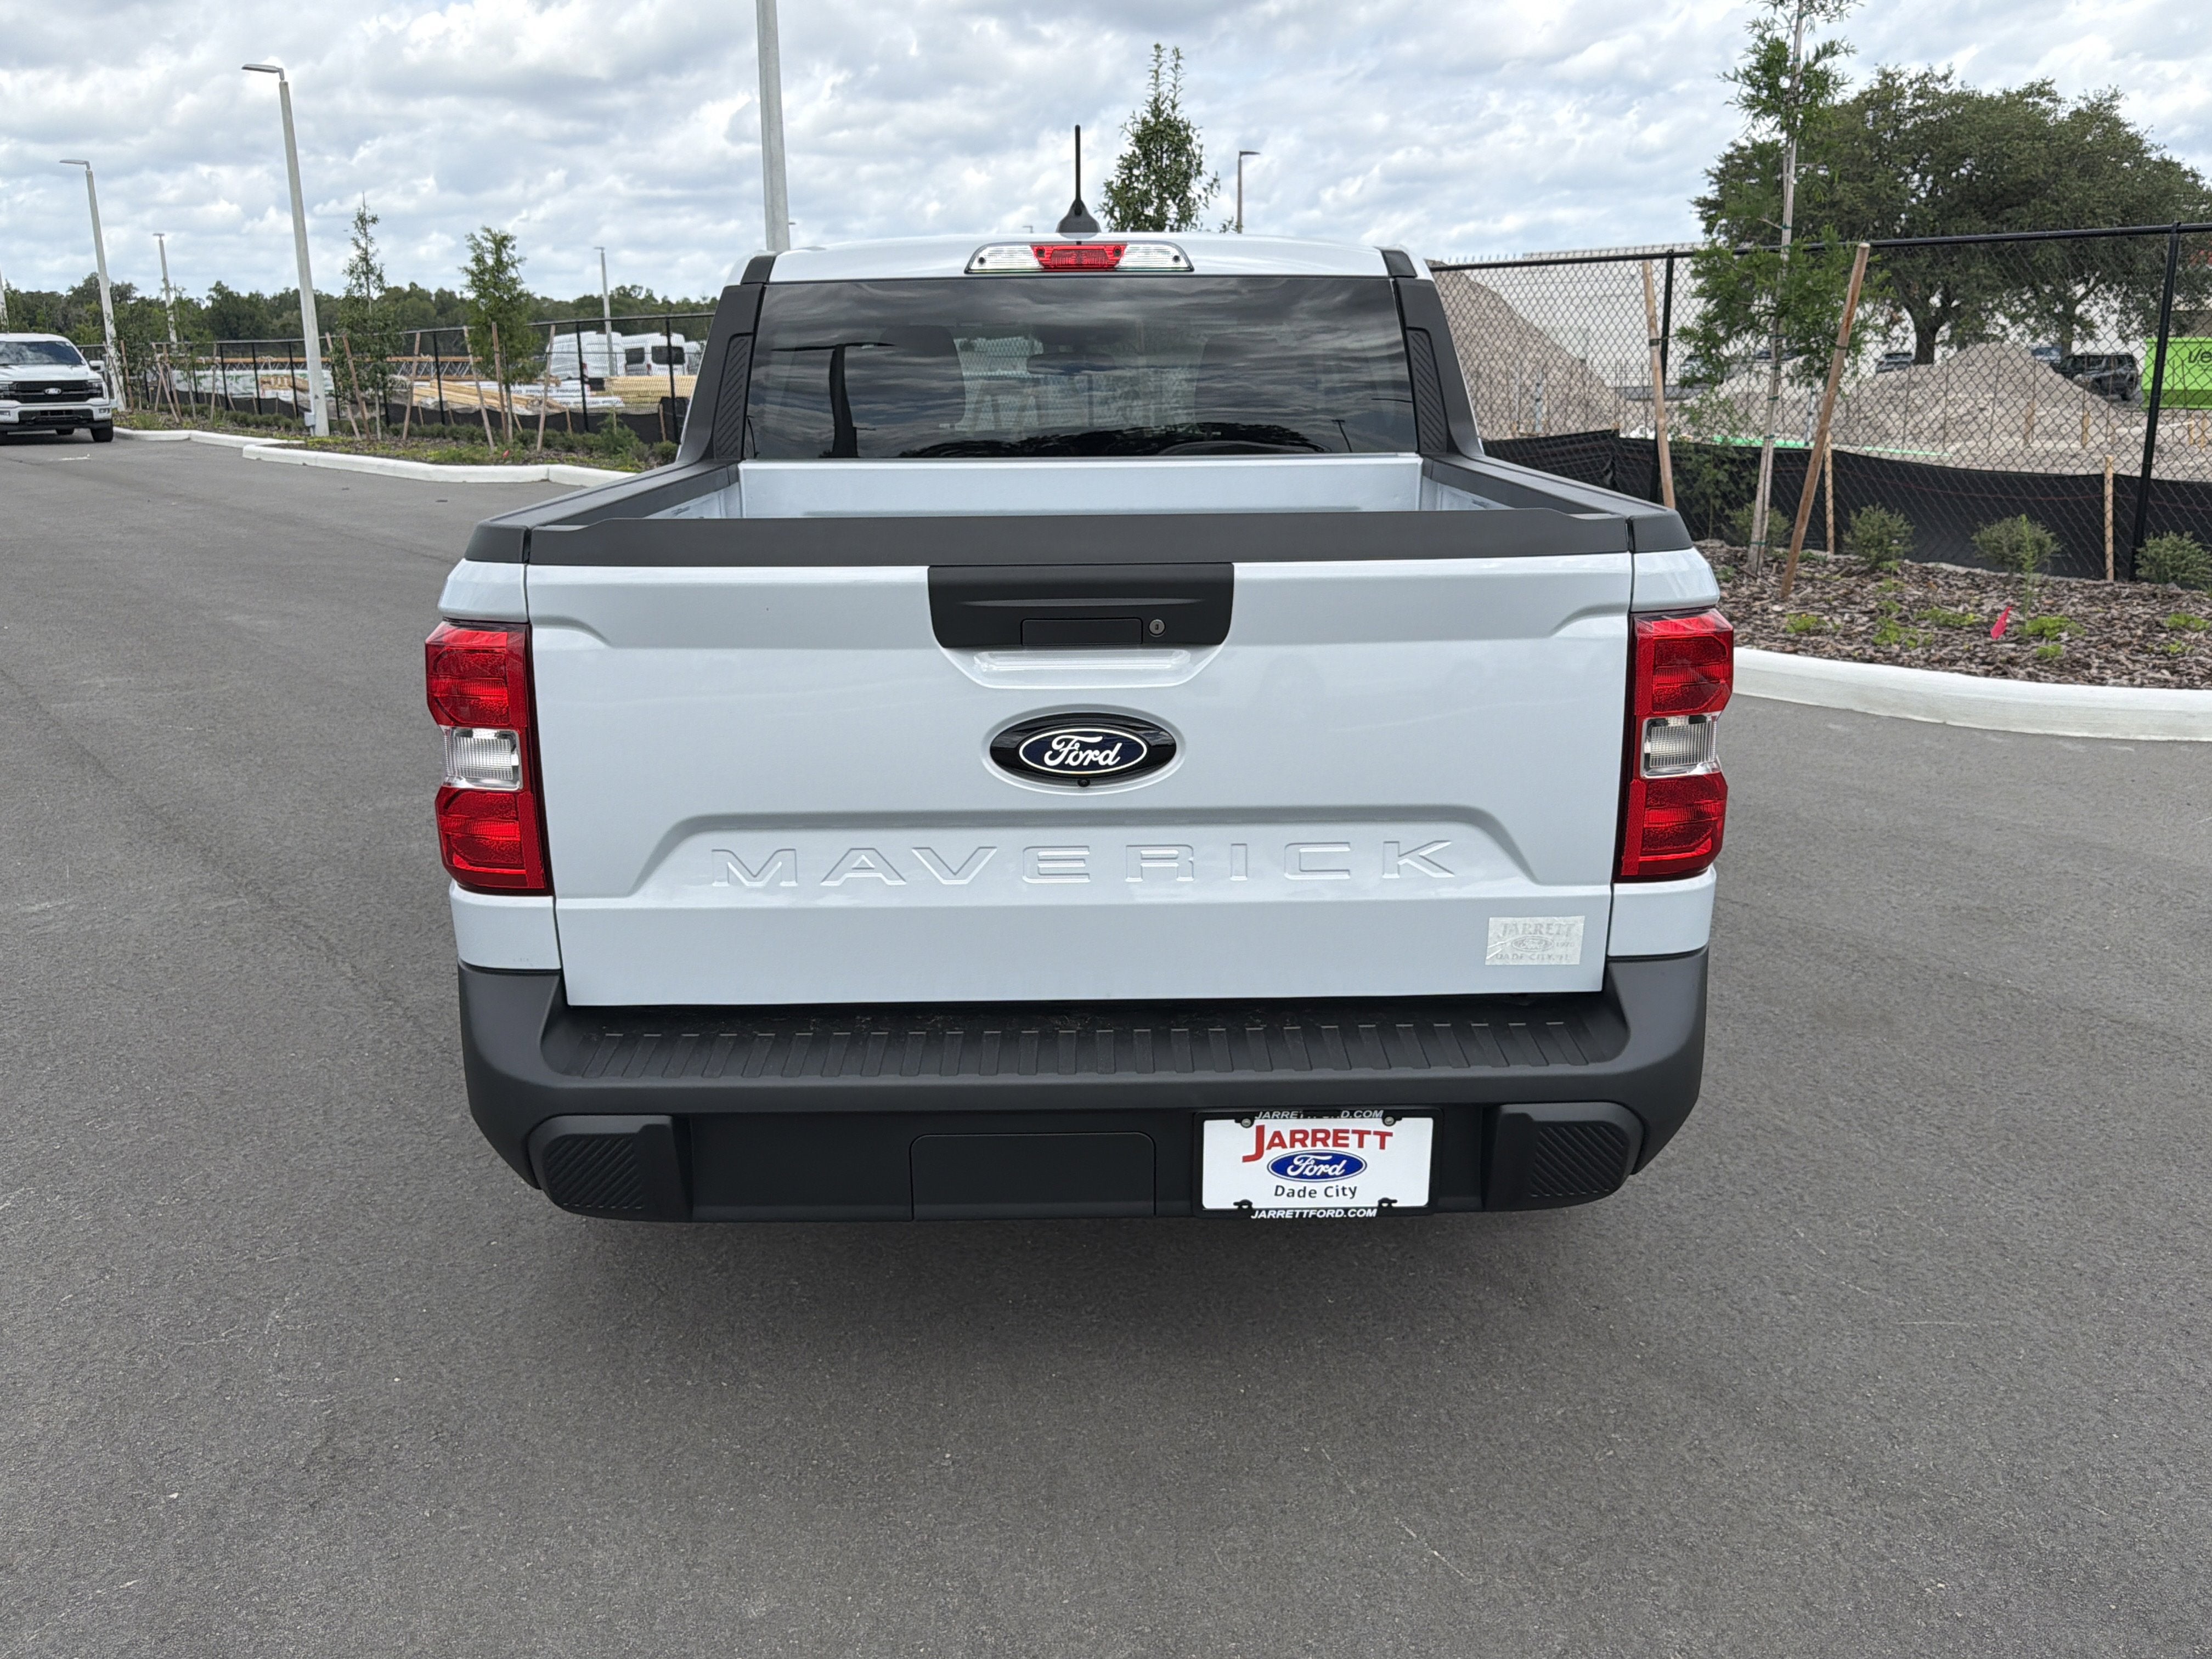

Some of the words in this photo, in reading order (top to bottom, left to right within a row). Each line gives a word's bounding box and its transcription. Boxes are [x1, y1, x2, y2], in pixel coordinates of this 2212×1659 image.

[1044, 735, 1122, 766] Ford
[712, 841, 1455, 887] MAVERICK
[1497, 923, 1575, 938] JARRETT
[1255, 1109, 1384, 1119] JARRED.COM
[1242, 1125, 1393, 1163] JARRETT
[1286, 1155, 1346, 1176] Ford
[1274, 1185, 1317, 1198] Dade
[1324, 1185, 1357, 1199] City
[1251, 1208, 1378, 1219] JARRETTFORD.COM
